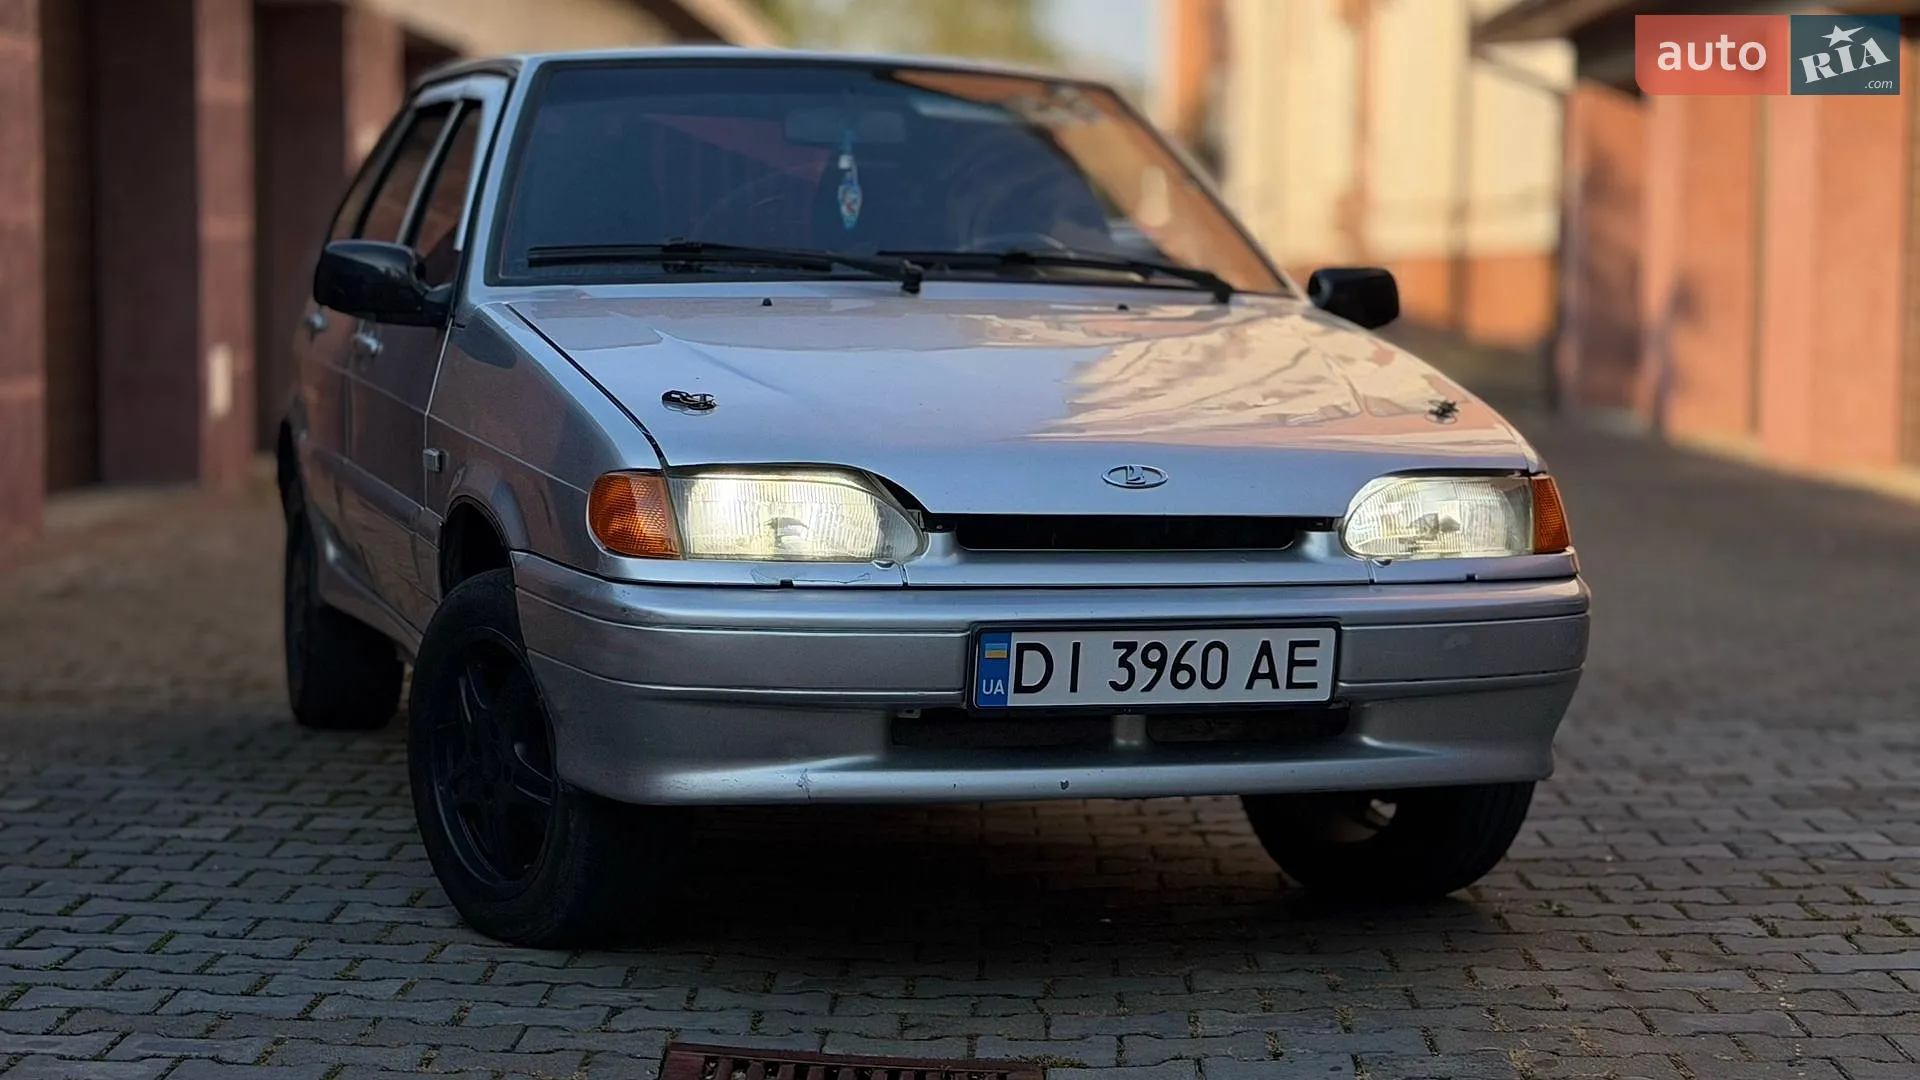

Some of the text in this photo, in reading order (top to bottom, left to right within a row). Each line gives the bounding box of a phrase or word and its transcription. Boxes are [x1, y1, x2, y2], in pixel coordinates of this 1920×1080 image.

[1013, 639, 1321, 694] DI 3960 AE
[982, 679, 1005, 695] UA
